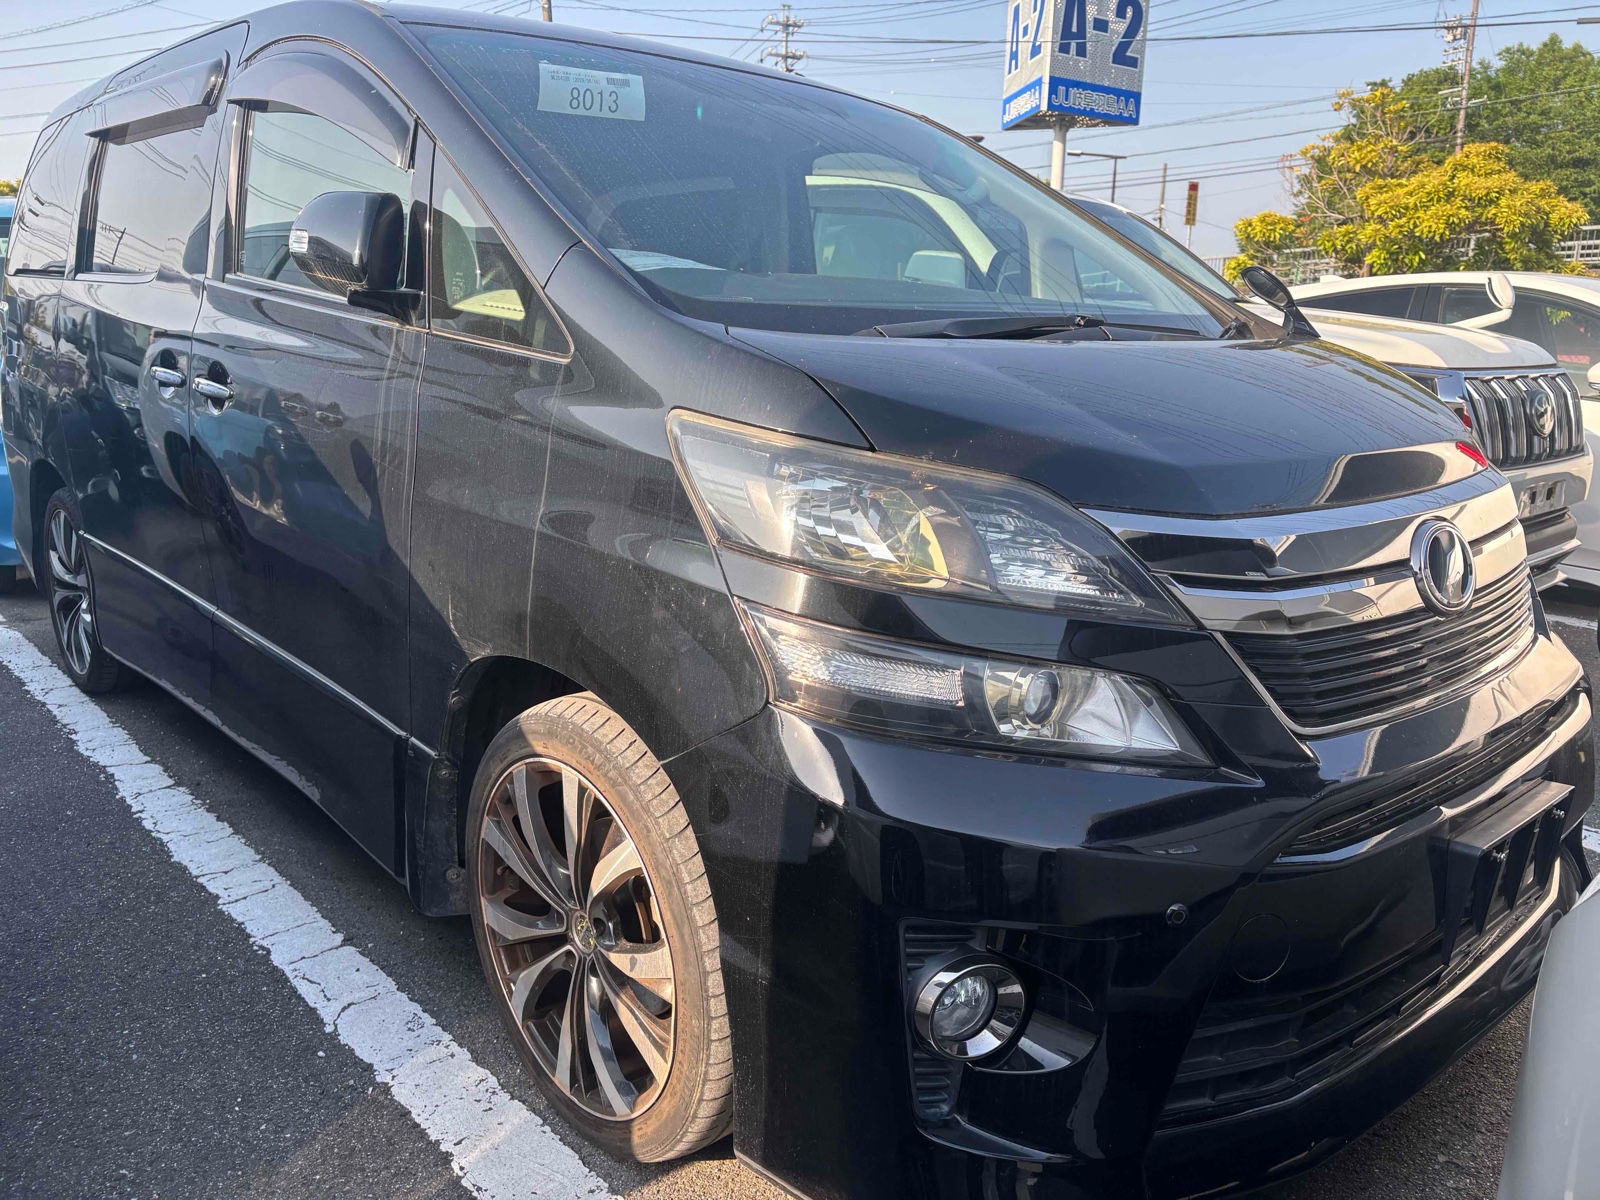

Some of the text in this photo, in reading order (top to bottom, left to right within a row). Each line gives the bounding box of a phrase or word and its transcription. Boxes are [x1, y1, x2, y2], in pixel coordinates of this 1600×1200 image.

[1007, 0, 1046, 76] A-2
[1057, 0, 1144, 70] A-2
[569, 87, 619, 113] 8013
[1051, 86, 1137, 119] JU岐阜羽島AA
